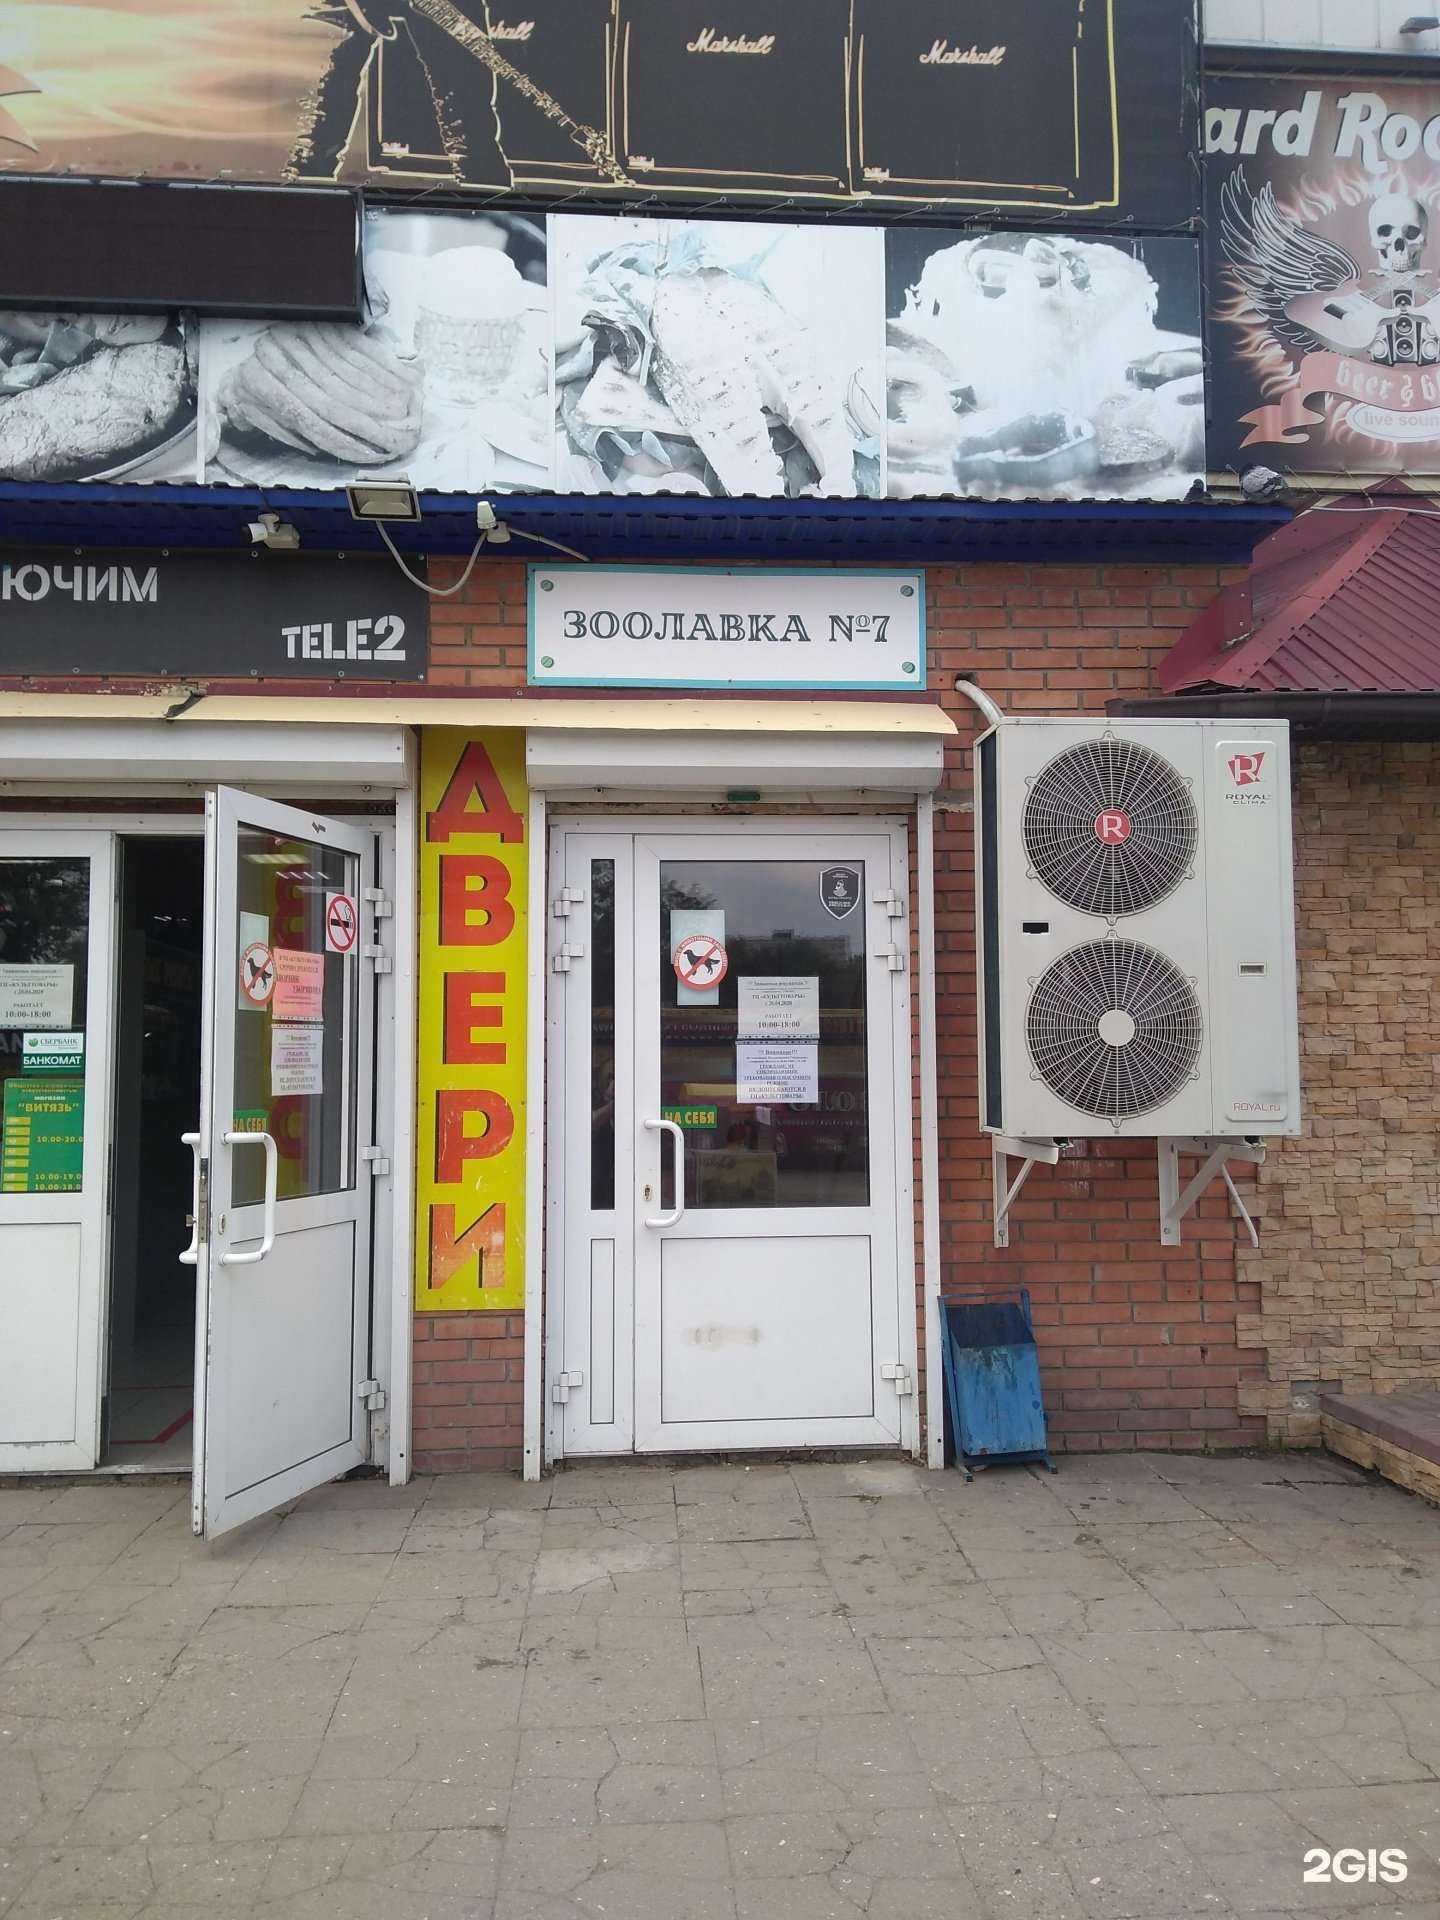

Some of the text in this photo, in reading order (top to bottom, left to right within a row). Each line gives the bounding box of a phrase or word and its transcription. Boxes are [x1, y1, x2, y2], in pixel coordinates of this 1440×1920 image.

[687, 27, 775, 55] Marshall
[919, 40, 1007, 66] Marshall
[1366, 411, 1393, 425] live
[2, 564, 158, 602] ЮЧИМ
[282, 615, 406, 661] TELE2
[563, 610, 812, 643] ЗООЛАВКА
[426, 741, 524, 1290] ДВЕРИ
[23, 1055, 82, 1066] БАНКОМАТ
[684, 1111, 715, 1125] СЕБЯ
